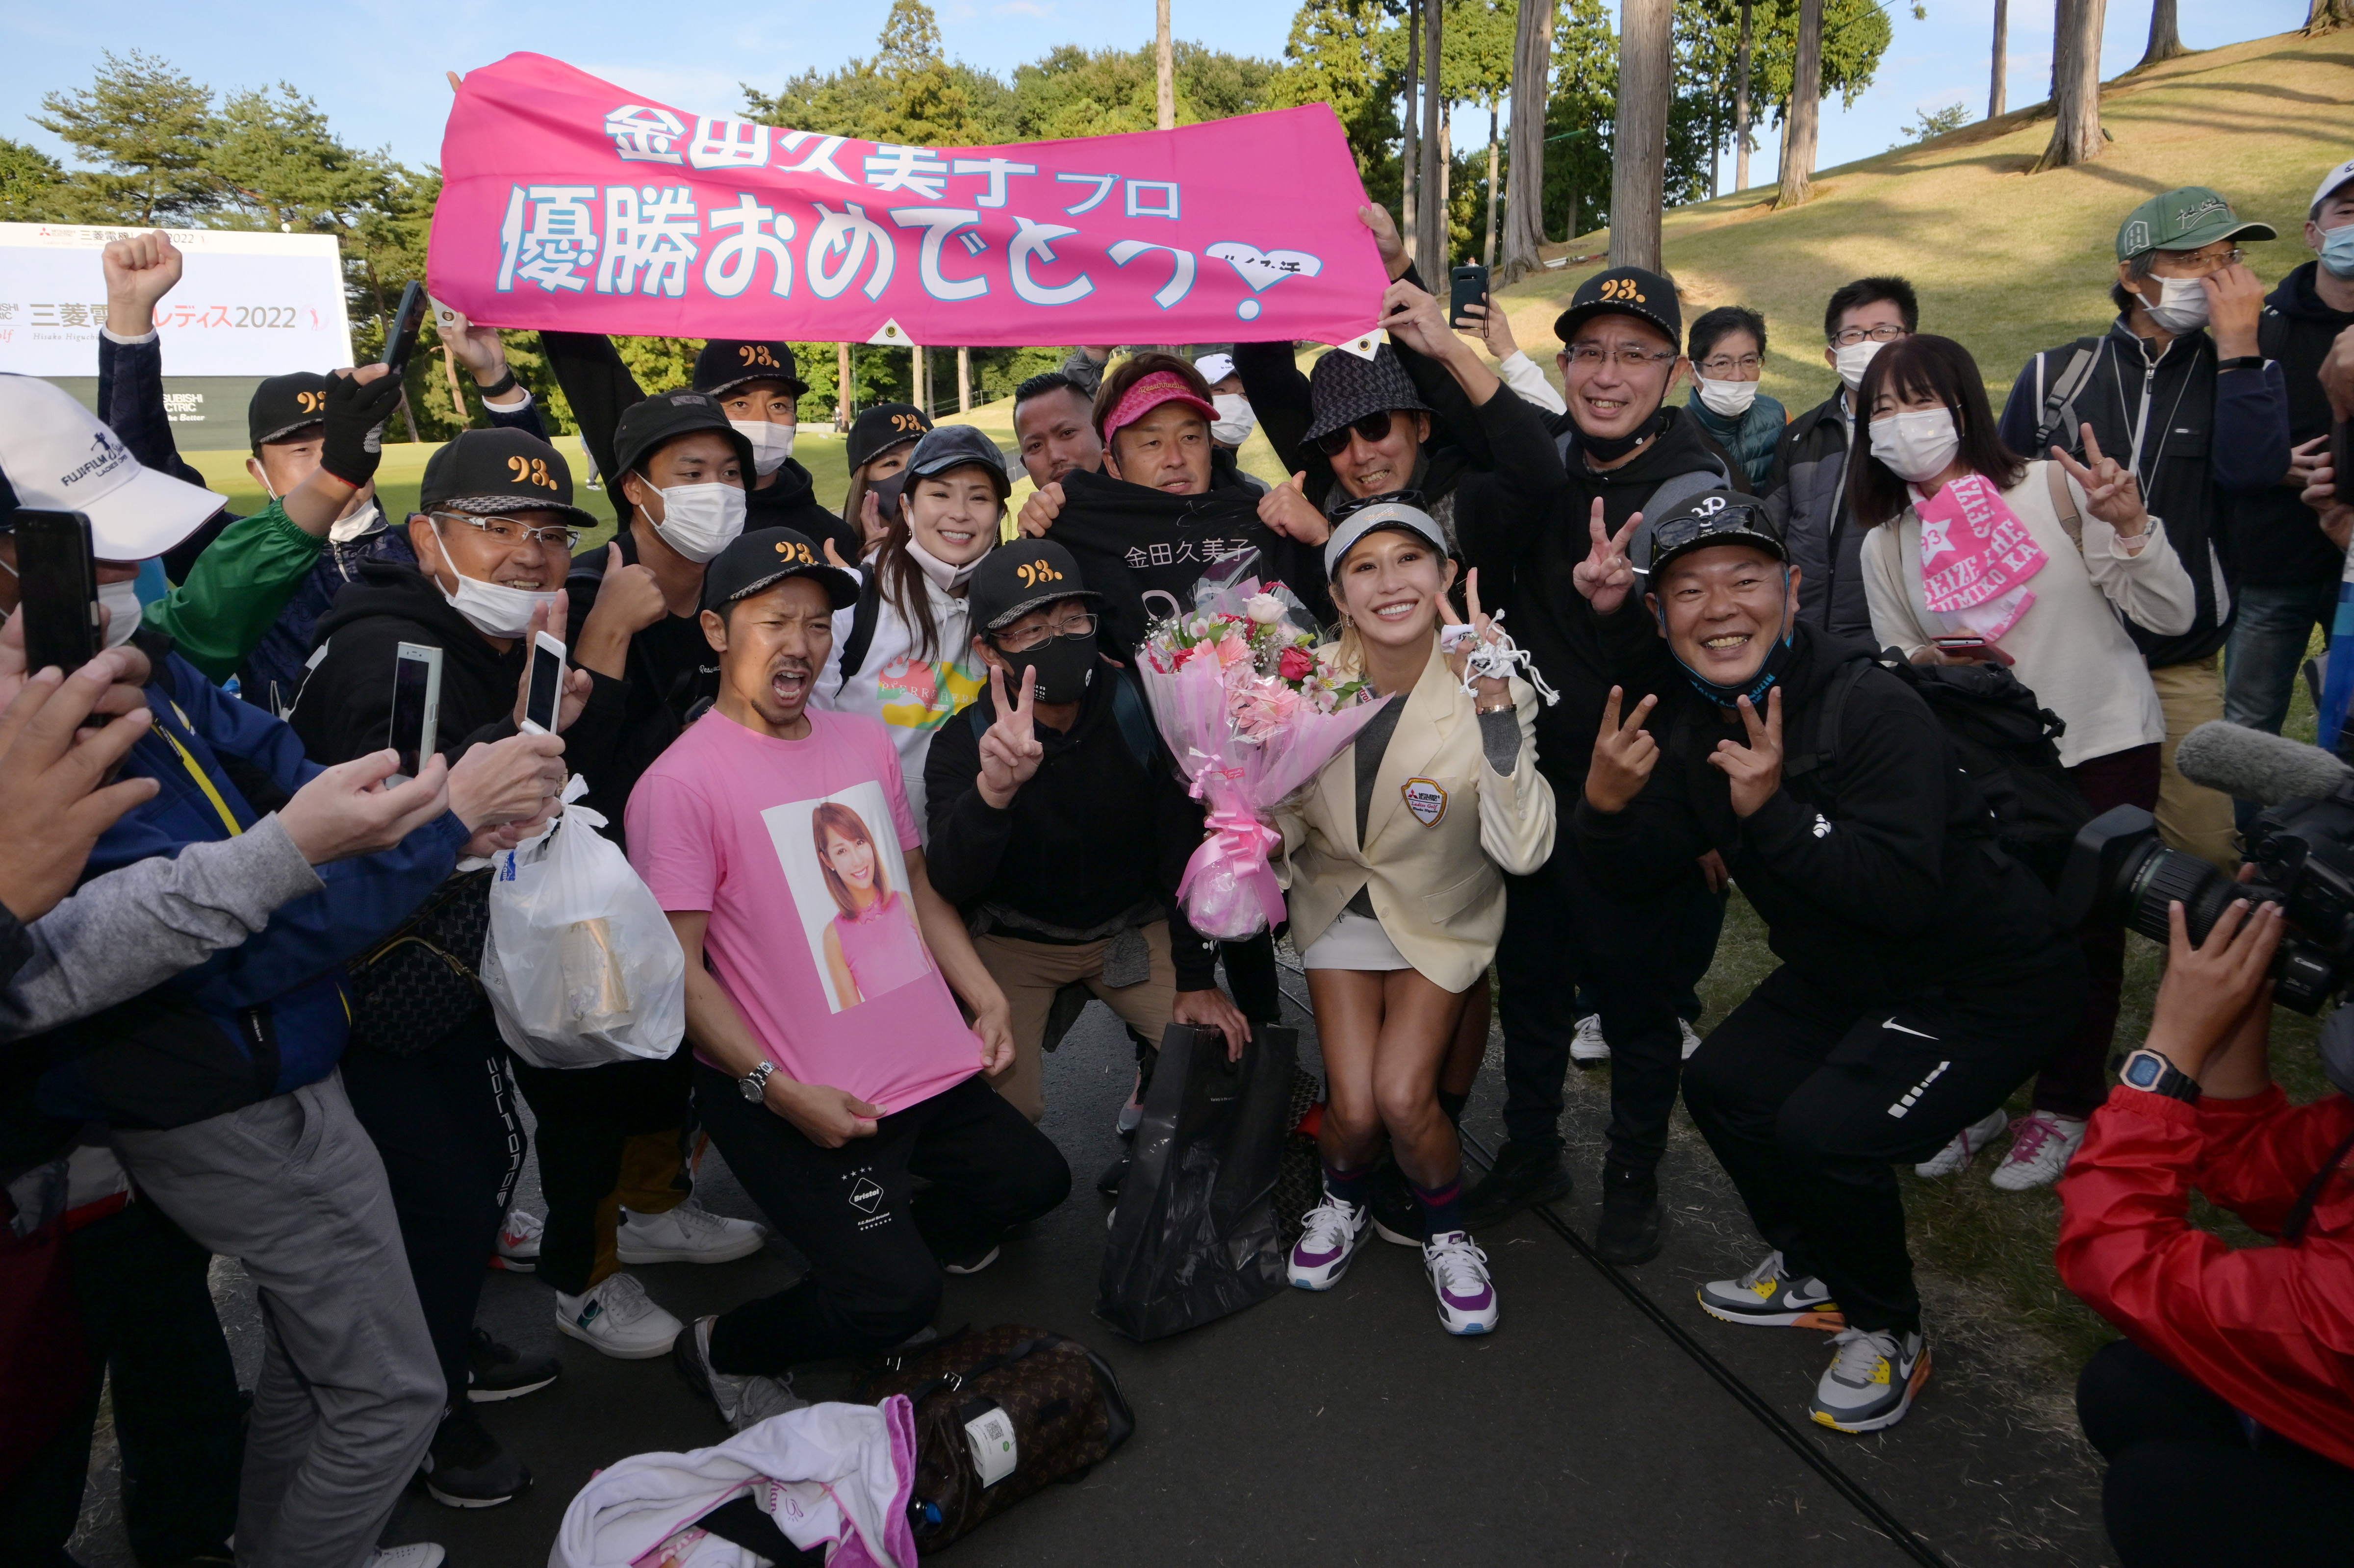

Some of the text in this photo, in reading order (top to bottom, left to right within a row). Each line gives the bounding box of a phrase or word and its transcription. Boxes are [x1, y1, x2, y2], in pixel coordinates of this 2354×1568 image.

[1055, 173, 1181, 221] プロ
[739, 345, 780, 368] 93.
[1138, 381, 1190, 394] Resurrection
[61, 454, 108, 486] FUJIFILM
[96, 461, 119, 477] LADIES
[508, 455, 558, 491] 93.
[1124, 538, 1249, 568] 金田久美子
[2002, 537, 2040, 573] KA
[1017, 559, 1064, 589] 93.
[881, 681, 937, 700] PIERRE
[854, 1188, 879, 1202] Bristol
